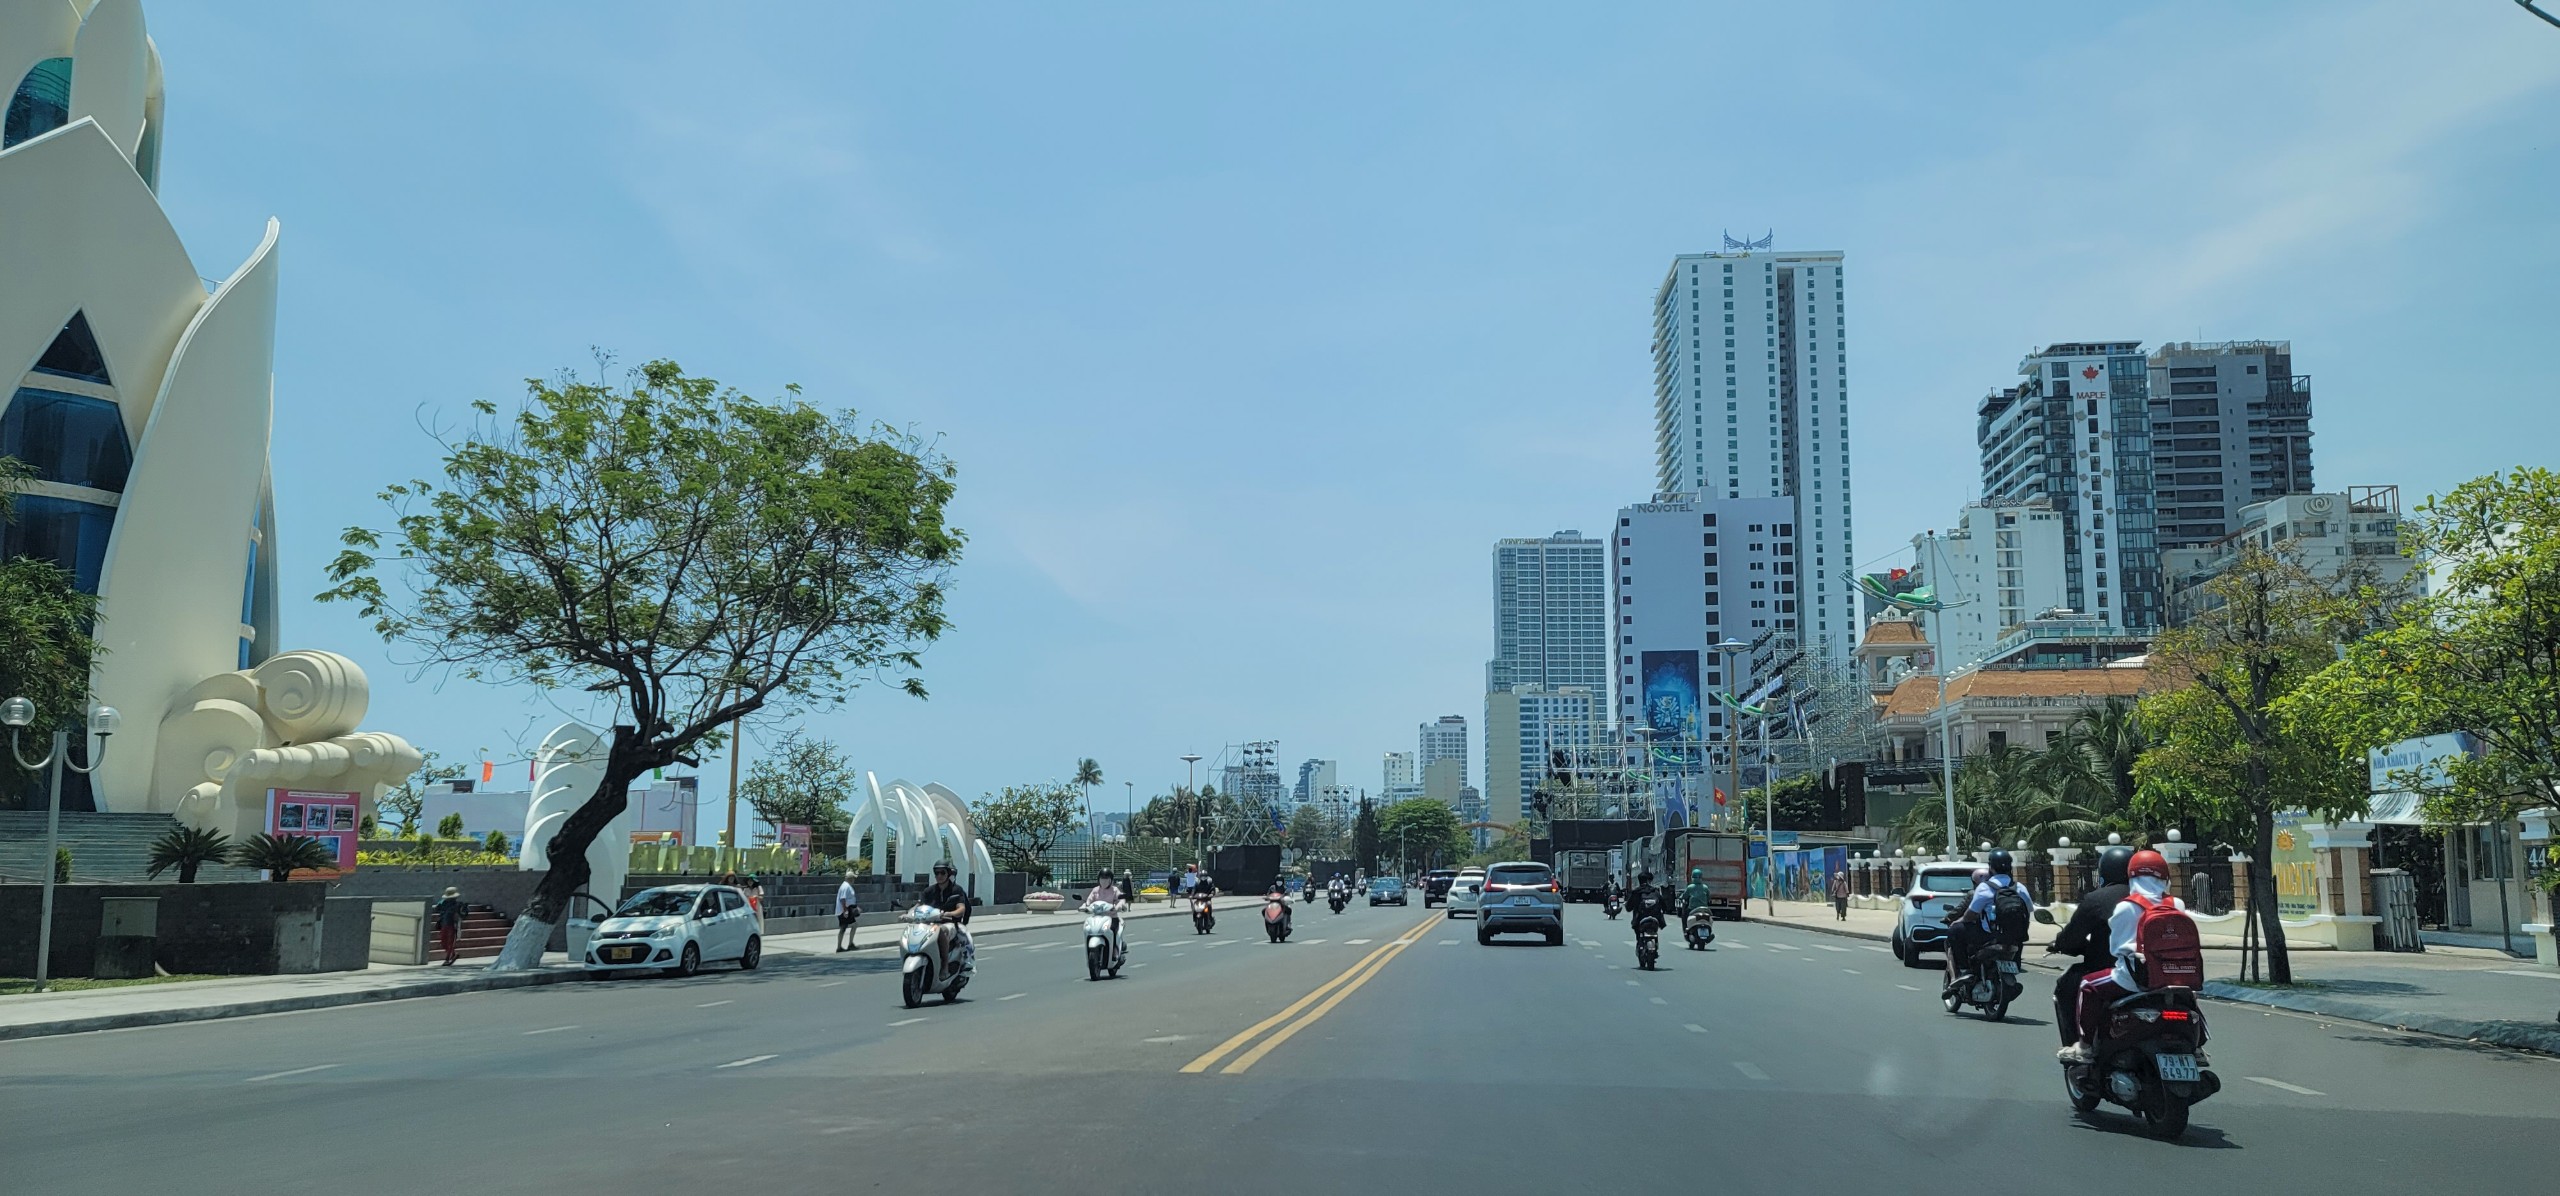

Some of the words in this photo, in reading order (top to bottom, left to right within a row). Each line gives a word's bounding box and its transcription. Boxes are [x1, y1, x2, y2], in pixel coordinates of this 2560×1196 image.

[2076, 391, 2106, 399] MAPLE
[1637, 502, 1694, 513] NOVOTEL
[1994, 499, 2022, 507] BOSS
[2528, 847, 2547, 868] 44
[2162, 1067, 2196, 1079] 649.77
